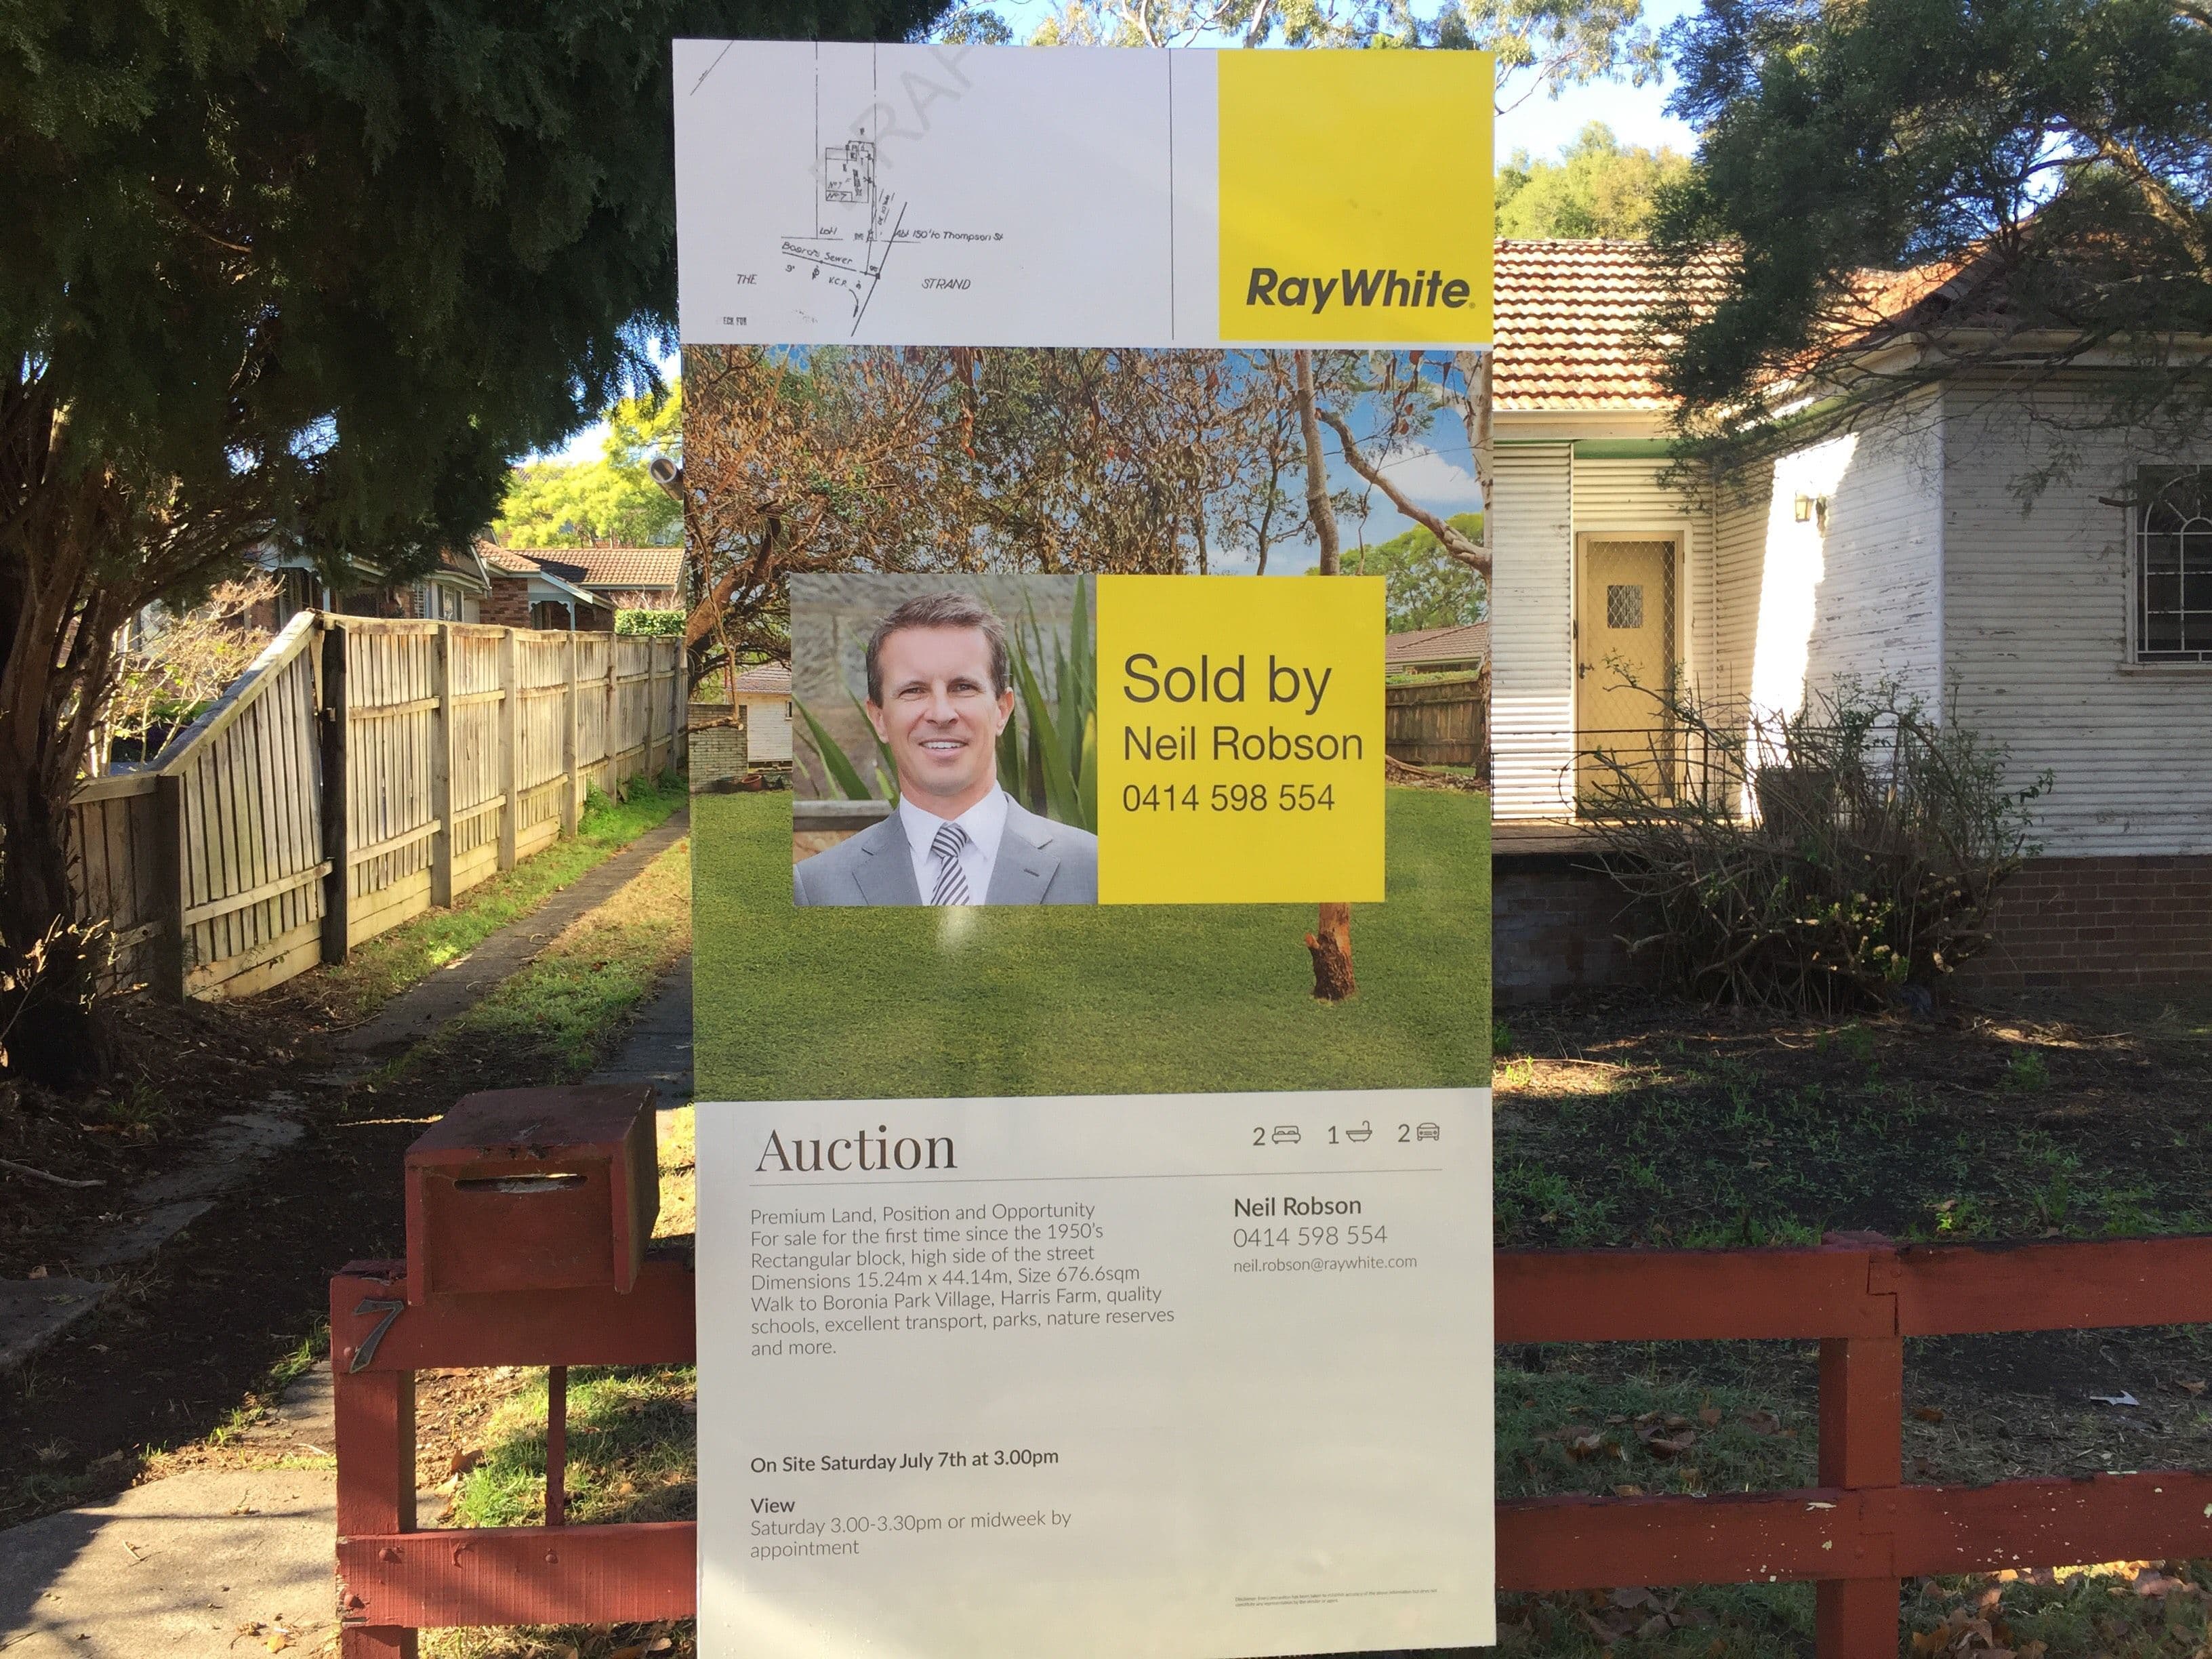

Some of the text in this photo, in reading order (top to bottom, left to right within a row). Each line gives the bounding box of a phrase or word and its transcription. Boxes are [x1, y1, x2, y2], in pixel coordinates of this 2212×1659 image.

[943, 230, 991, 242] Thompson
[823, 251, 853, 265] Sewer
[737, 273, 971, 290] THE STRAND
[1246, 267, 1470, 314] RayWhite
[1123, 653, 1332, 716] Sold by
[1124, 725, 1362, 761] Neil Robson
[1123, 783, 1335, 812] 0414 598 554
[1252, 1123, 1410, 1147] 2 1 2
[755, 1124, 958, 1172] Auction
[751, 1202, 1095, 1225] Premium Land, Position and Opportunity
[1234, 1195, 1361, 1218] Neil Robson
[751, 1231, 779, 1247] For
[784, 1229, 817, 1246] sale
[821, 1229, 847, 1245] for
[852, 1228, 880, 1245] the
[884, 1227, 918, 1244] first
[923, 1226, 960, 1243] time
[966, 1225, 1008, 1242] since
[1014, 1224, 1042, 1240] the
[1233, 1225, 1388, 1248] 0414 598 554
[752, 1245, 1095, 1271] Rectangular block, high side of the street
[1233, 1255, 1417, 1273] neil.robson@raywhite.com
[752, 1265, 1140, 1291] Dimensions 15.24m x 44.14m, Size 676.6sqm
[750, 1286, 1162, 1312] Walk to Boronia Park Village, Harris Farm, quality
[751, 1310, 1175, 1335] schools, excellent transport, parks, nature reserves
[350, 1299, 404, 1374] 7
[751, 1339, 836, 1357] and more.
[750, 1448, 1059, 1473] On Site Saturday July 7th at 3.00pm
[750, 1497, 796, 1514] View
[750, 1509, 1072, 1538] Saturday 3.00-3.30pm or midweek by
[750, 1539, 860, 1561] appointment
